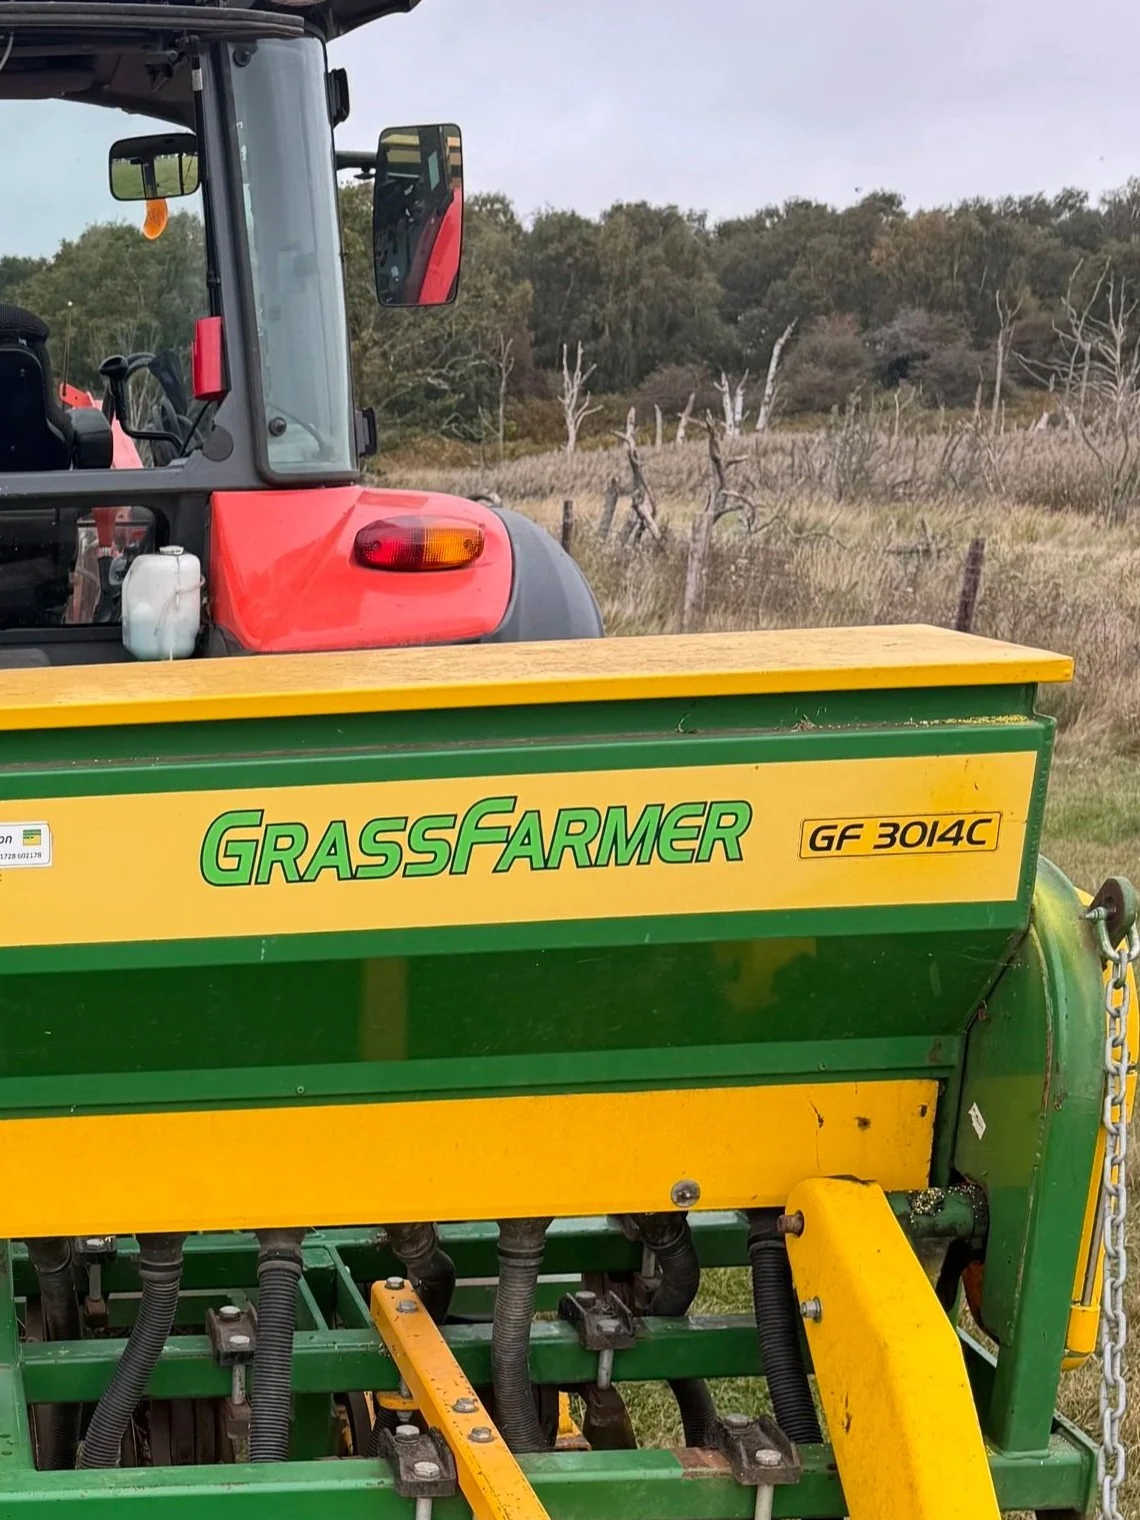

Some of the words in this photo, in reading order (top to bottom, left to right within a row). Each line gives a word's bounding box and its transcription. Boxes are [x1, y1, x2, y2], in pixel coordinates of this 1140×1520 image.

[200, 796, 752, 887] GRASSFARMER
[809, 824, 864, 851] GF
[872, 818, 992, 850] 3014C
